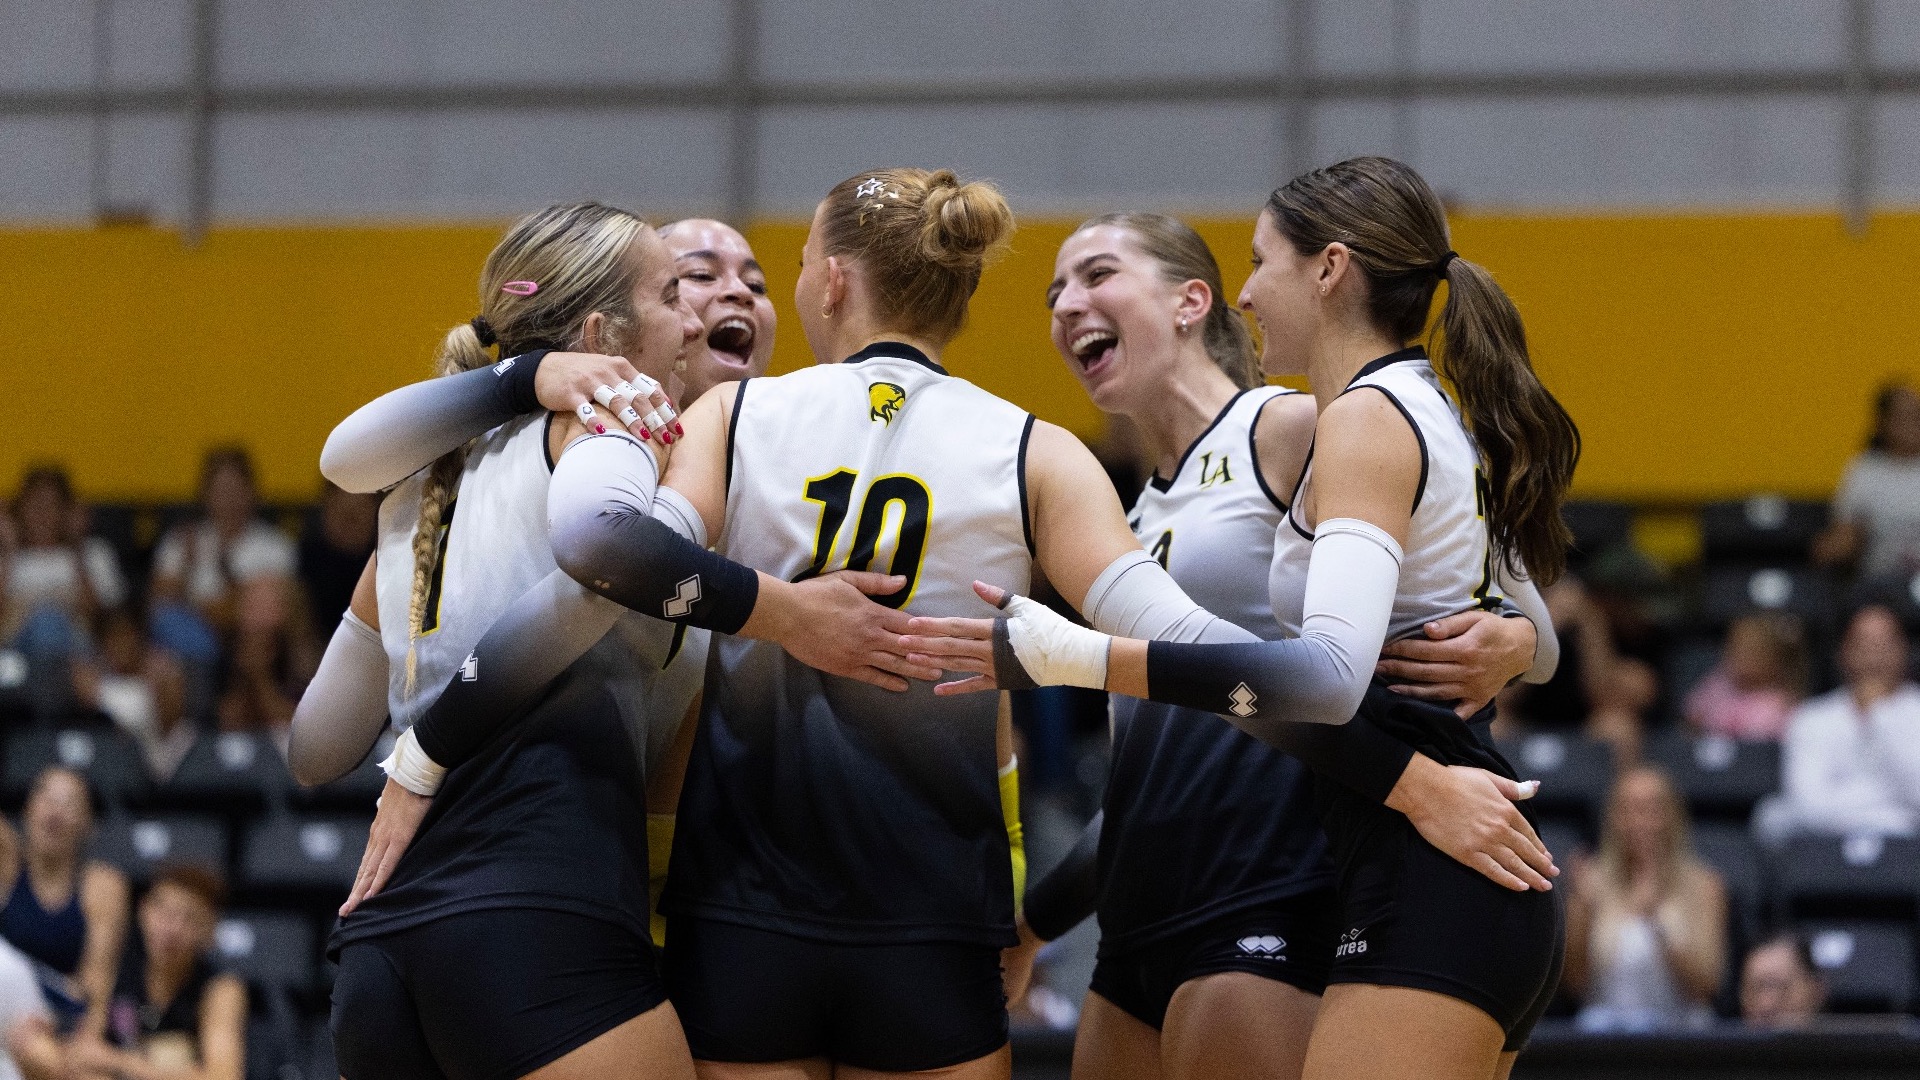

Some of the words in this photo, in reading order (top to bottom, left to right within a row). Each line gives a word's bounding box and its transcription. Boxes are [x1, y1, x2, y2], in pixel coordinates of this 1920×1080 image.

[1199, 450, 1235, 491] LA
[800, 466, 935, 612] 10
[1335, 940, 1368, 958] rrea
